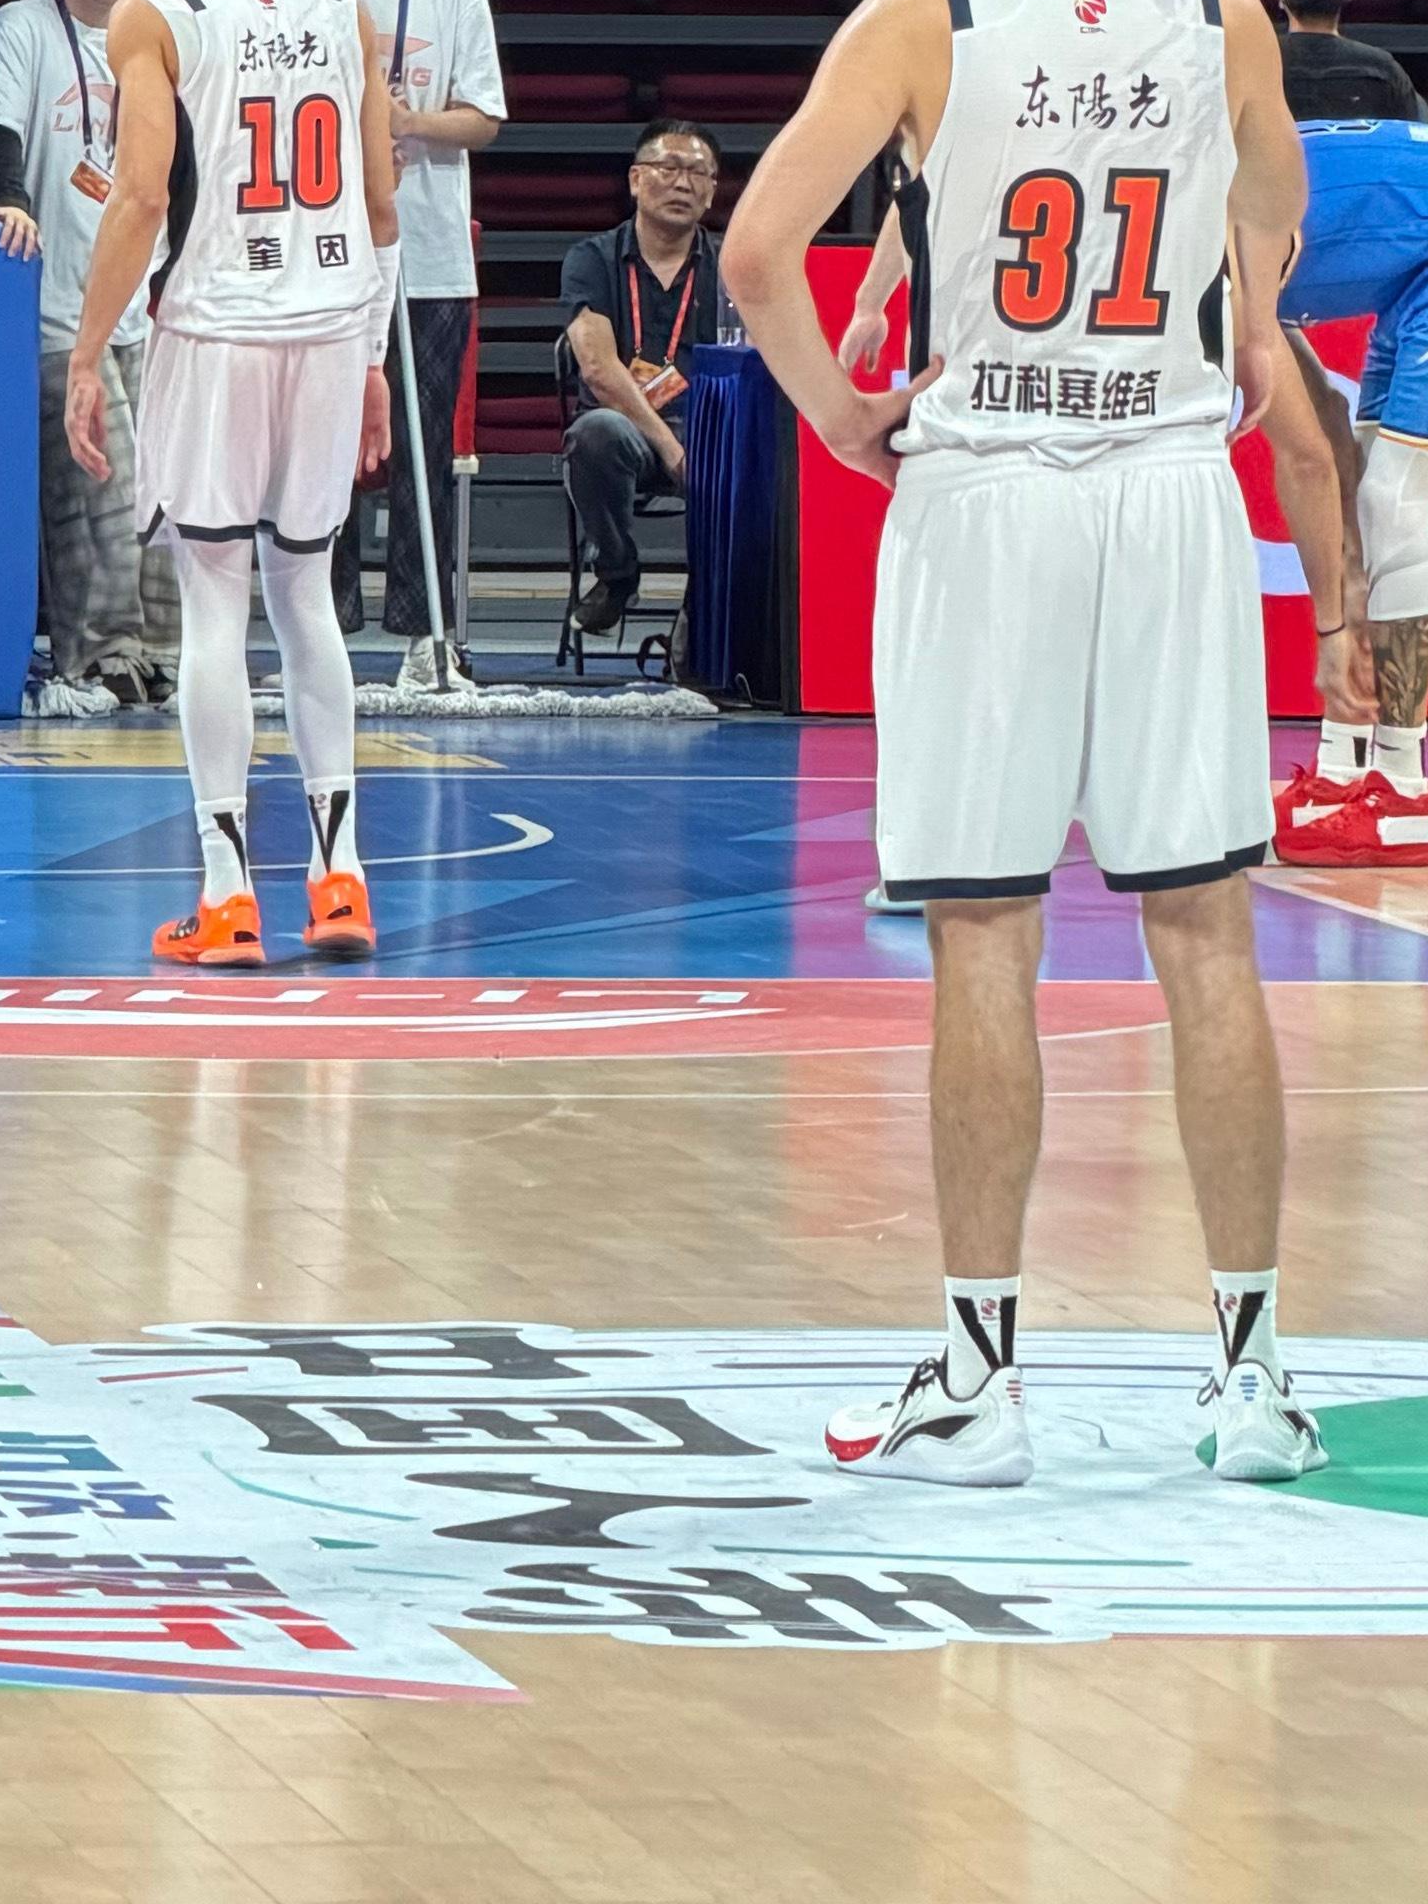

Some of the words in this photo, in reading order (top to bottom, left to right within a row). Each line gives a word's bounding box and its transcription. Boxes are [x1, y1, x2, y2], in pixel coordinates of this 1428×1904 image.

[236, 92, 344, 215] 10
[992, 166, 1172, 338] 31
[970, 357, 1163, 421] 拉科塞维奇
